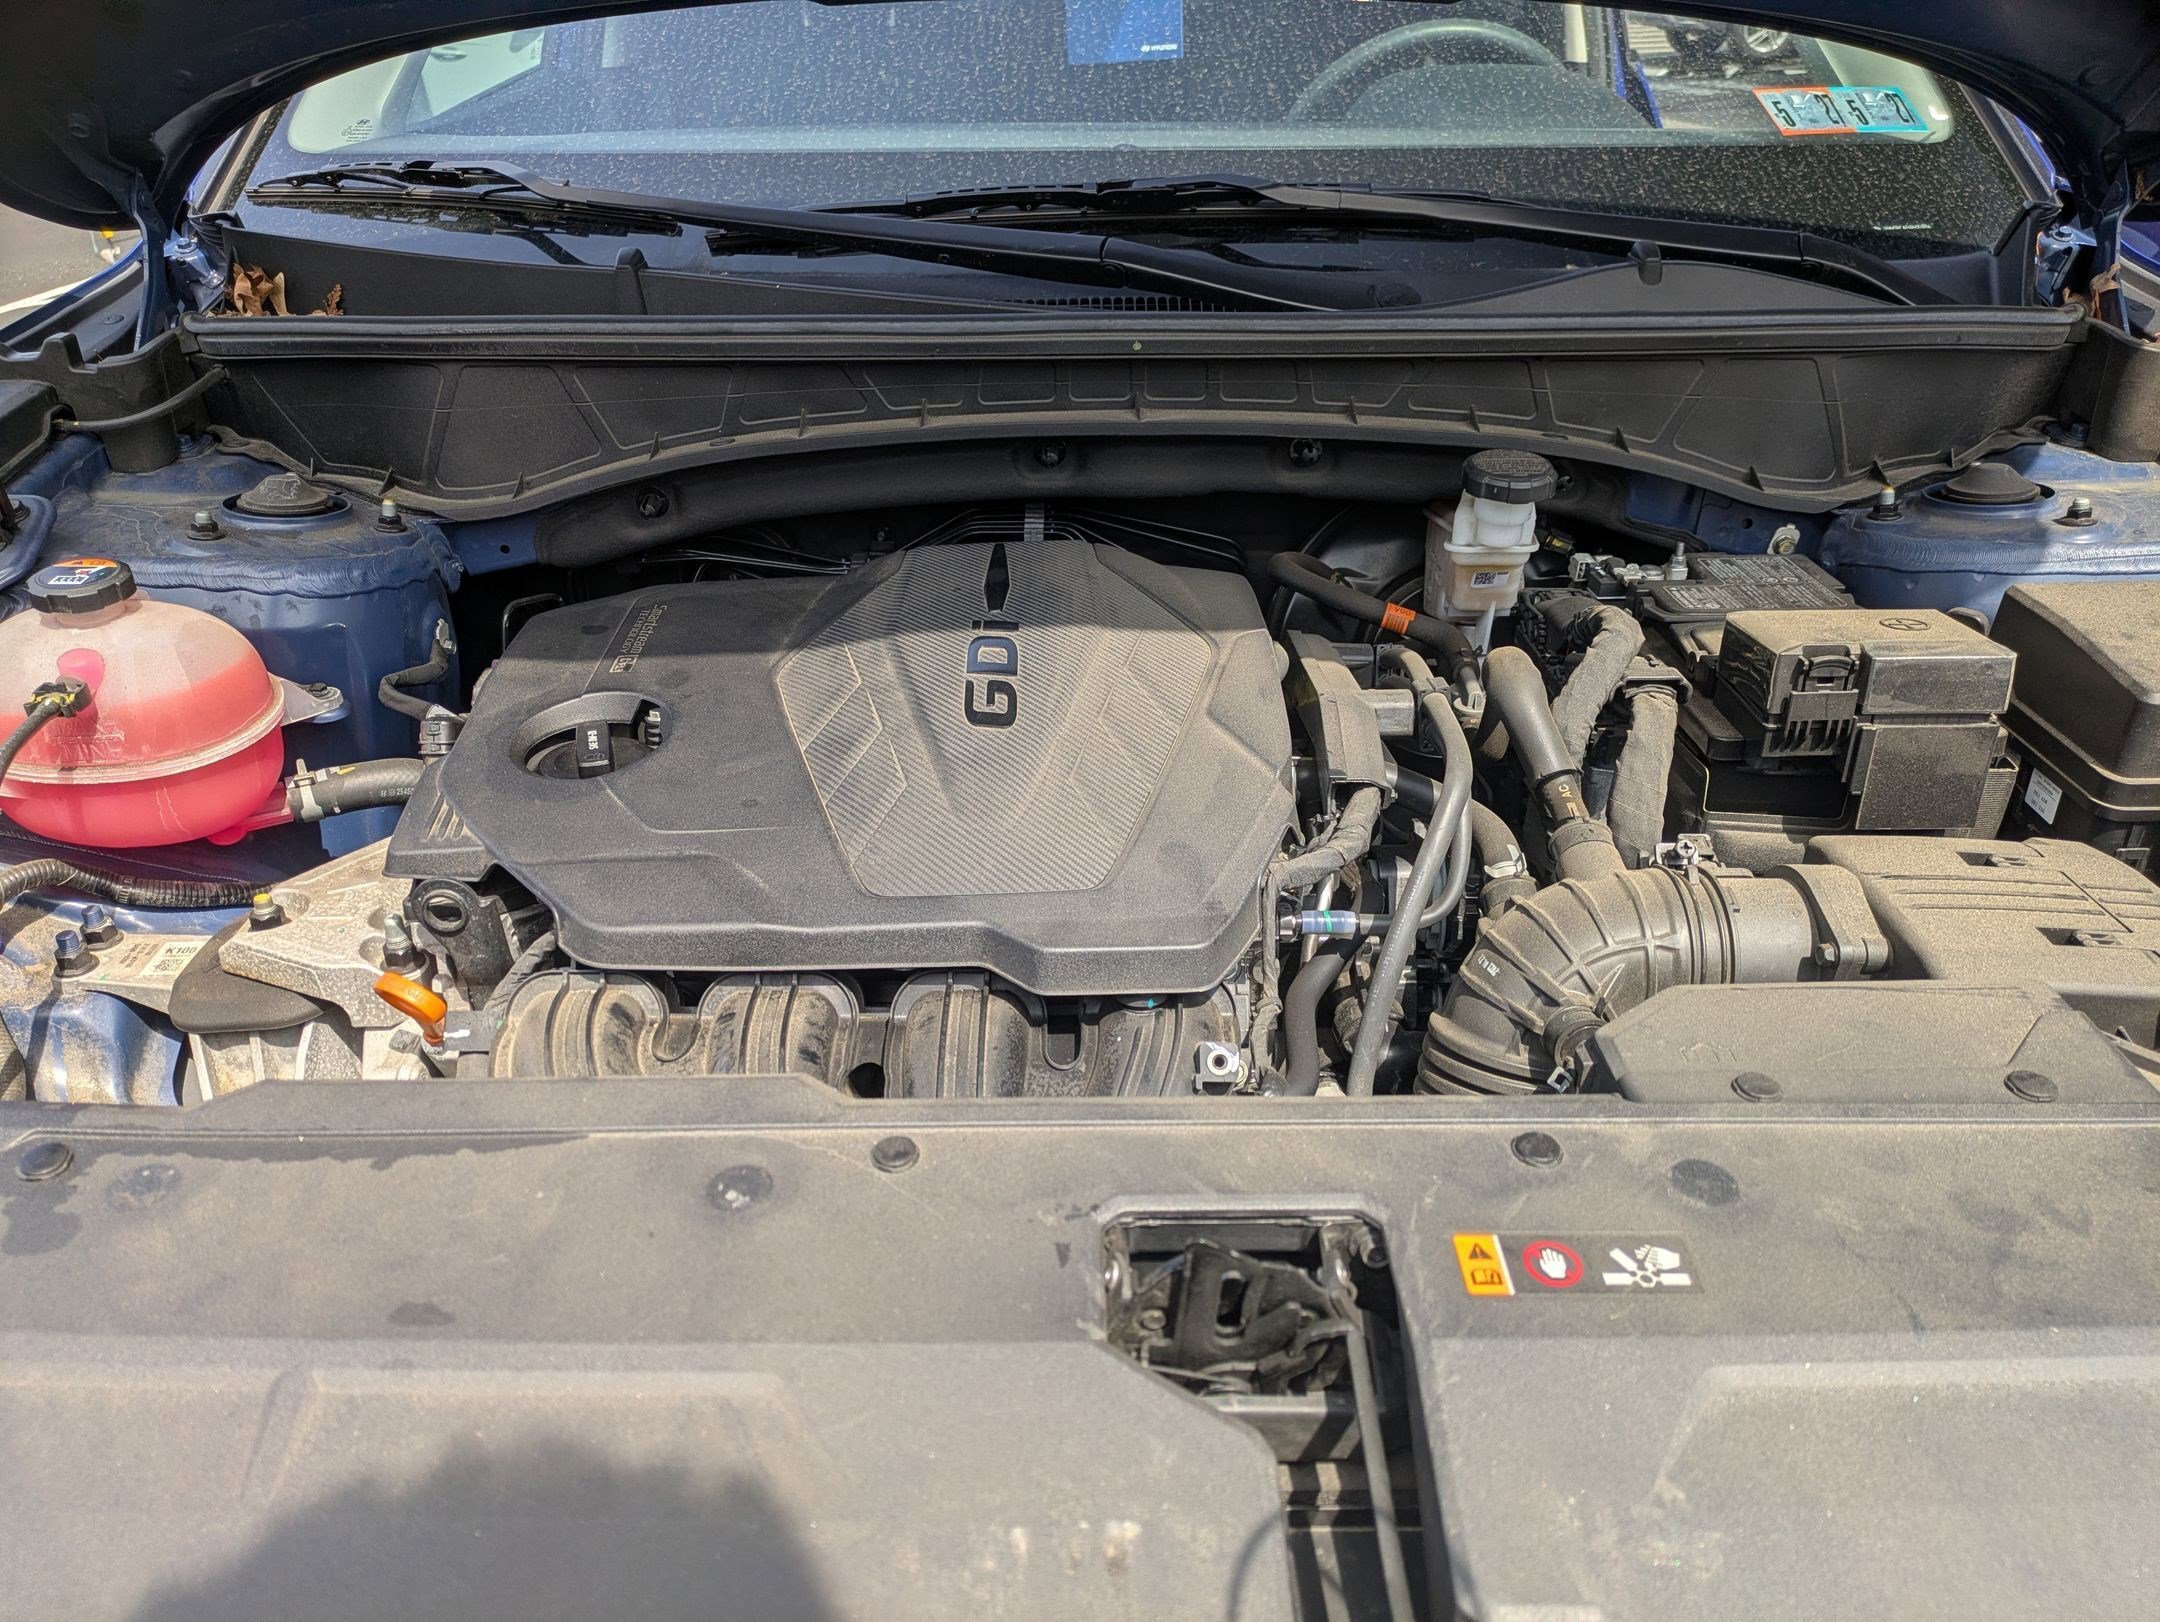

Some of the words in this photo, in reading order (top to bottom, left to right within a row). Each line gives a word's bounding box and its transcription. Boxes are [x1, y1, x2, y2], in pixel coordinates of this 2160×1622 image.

[1771, 101, 1796, 127] 5
[1813, 94, 1846, 127] 27
[1845, 100, 1869, 126] 5
[1883, 93, 1916, 124] 27
[619, 608, 651, 653] TECHNOLOGY
[630, 604, 668, 654] Smartstream
[964, 620, 1020, 727] GDi
[1558, 784, 1573, 798] AC
[165, 947, 198, 955] K100
